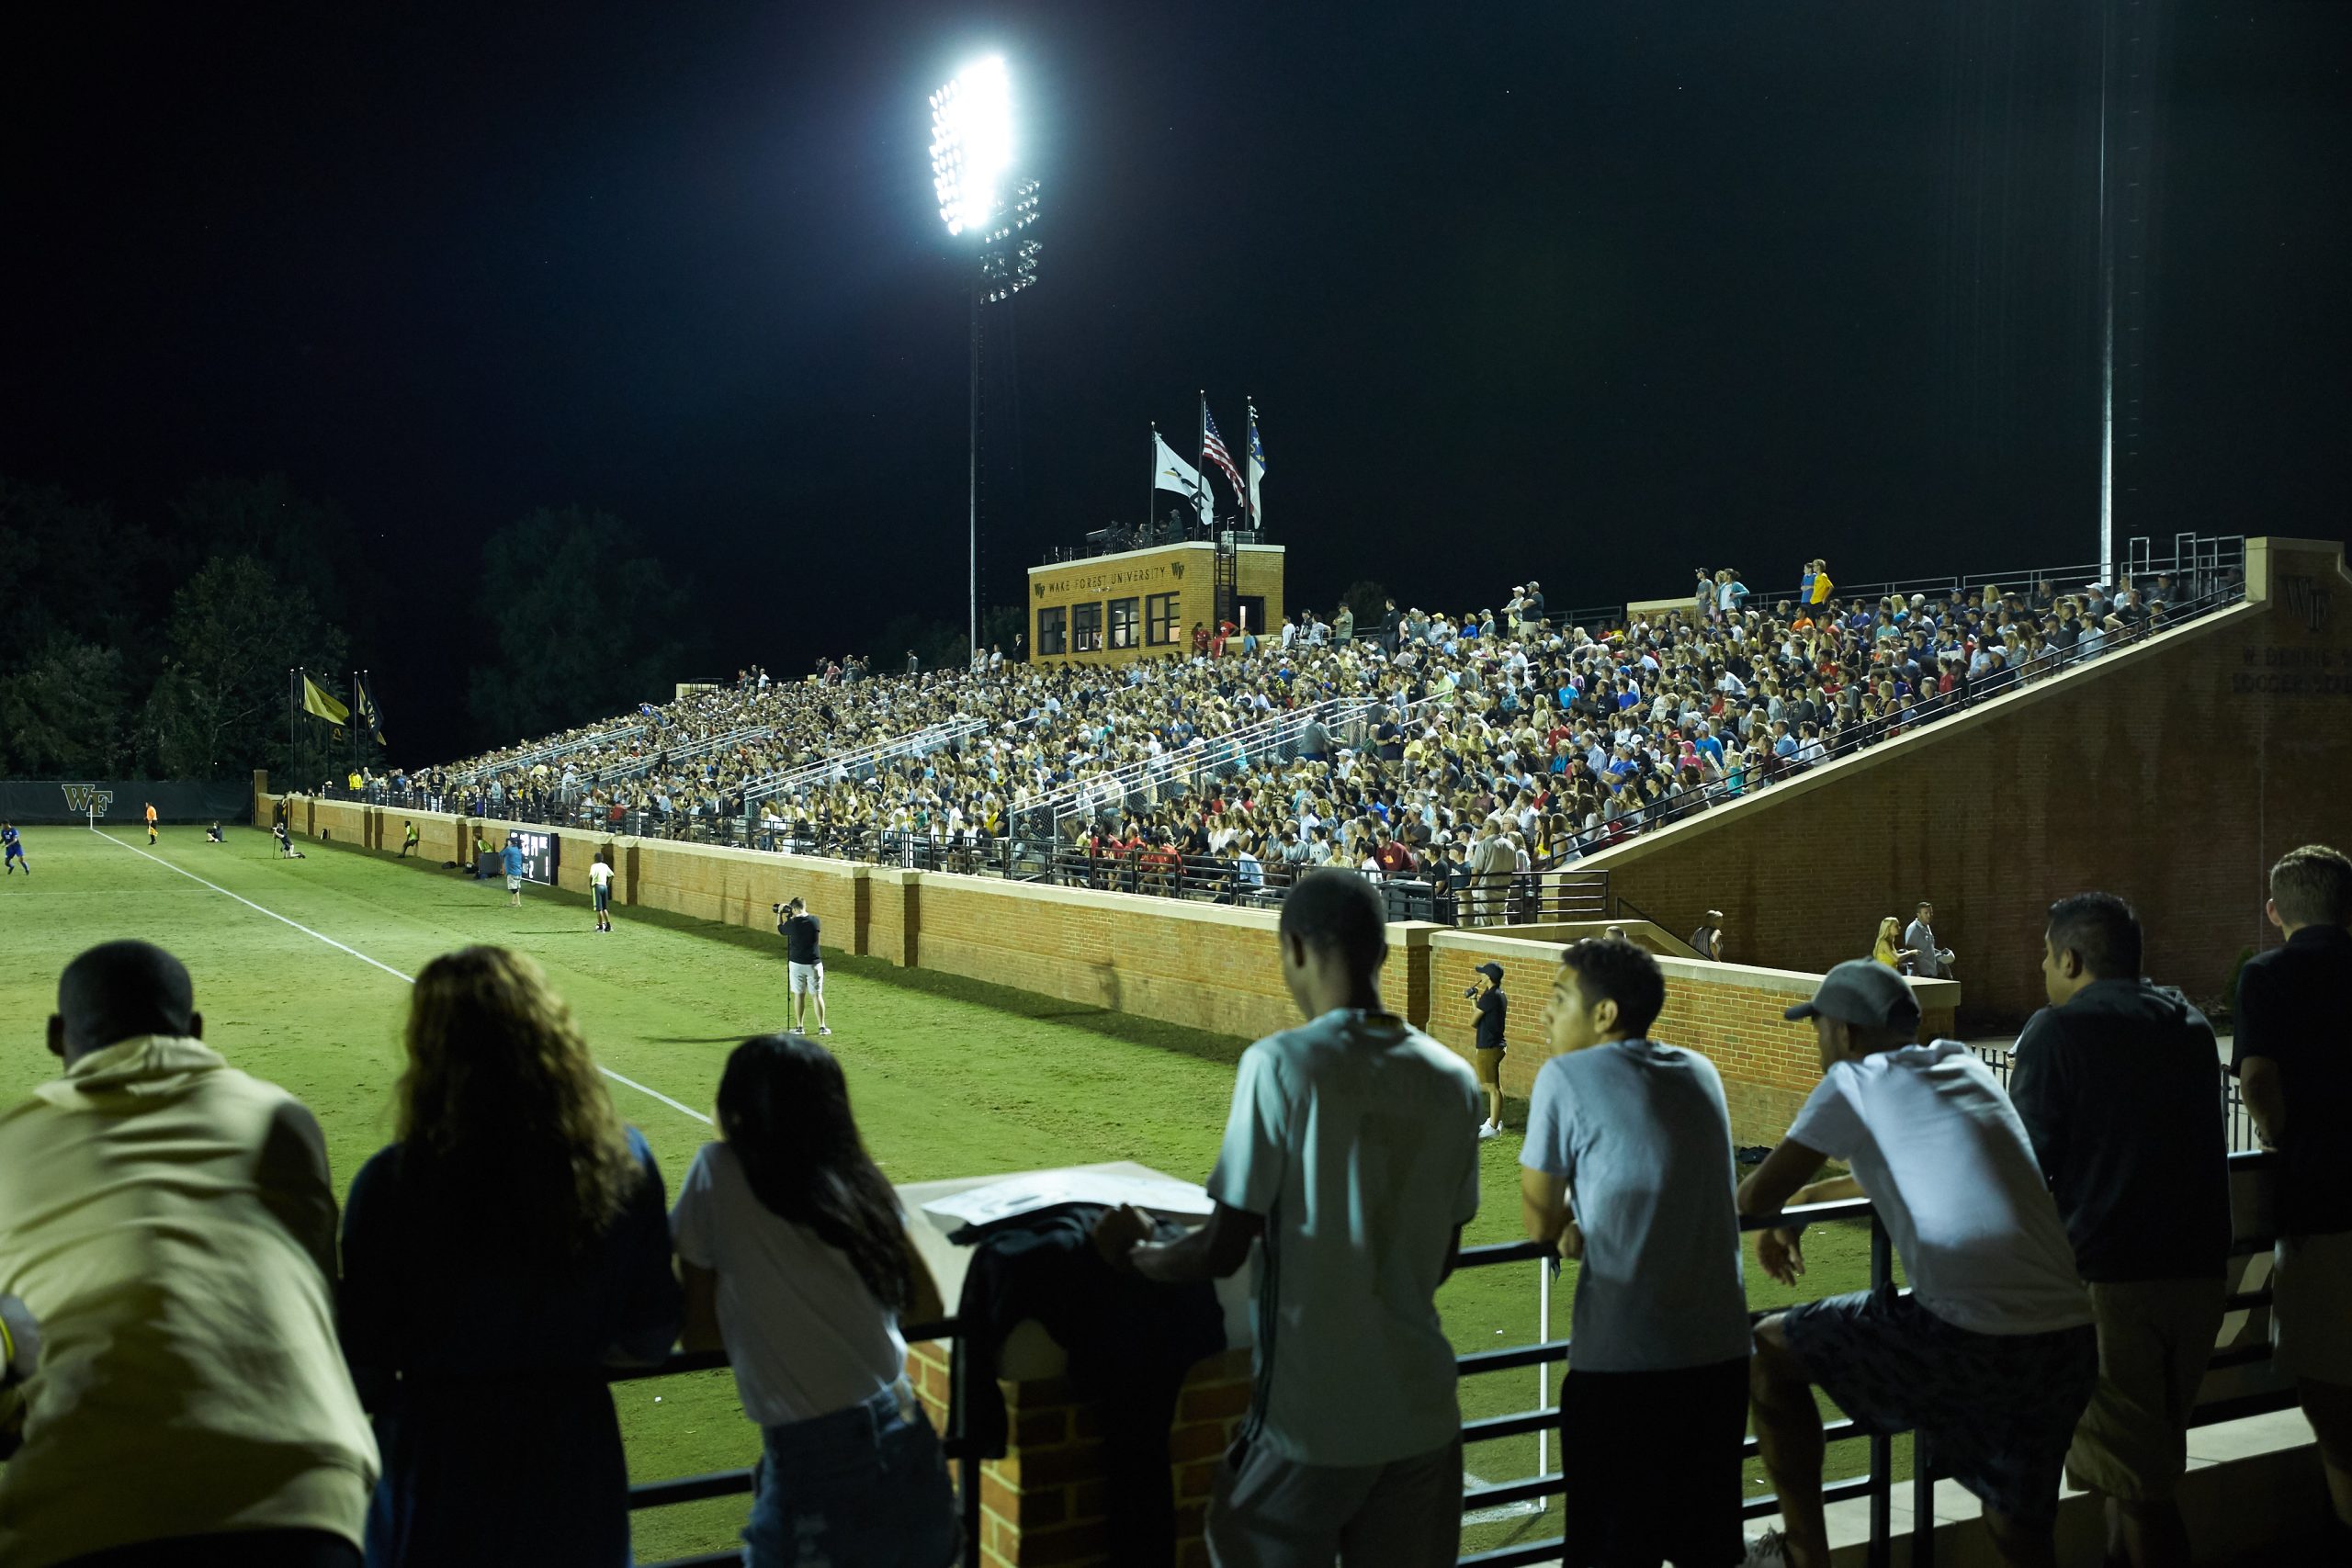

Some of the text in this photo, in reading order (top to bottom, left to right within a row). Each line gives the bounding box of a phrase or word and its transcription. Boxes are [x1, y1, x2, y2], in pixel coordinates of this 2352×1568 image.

[1049, 581, 1070, 592] WAKE
[1076, 575, 1106, 590] FOREST
[1111, 566, 1165, 584] UNIVERSITY
[62, 784, 113, 817] WF
